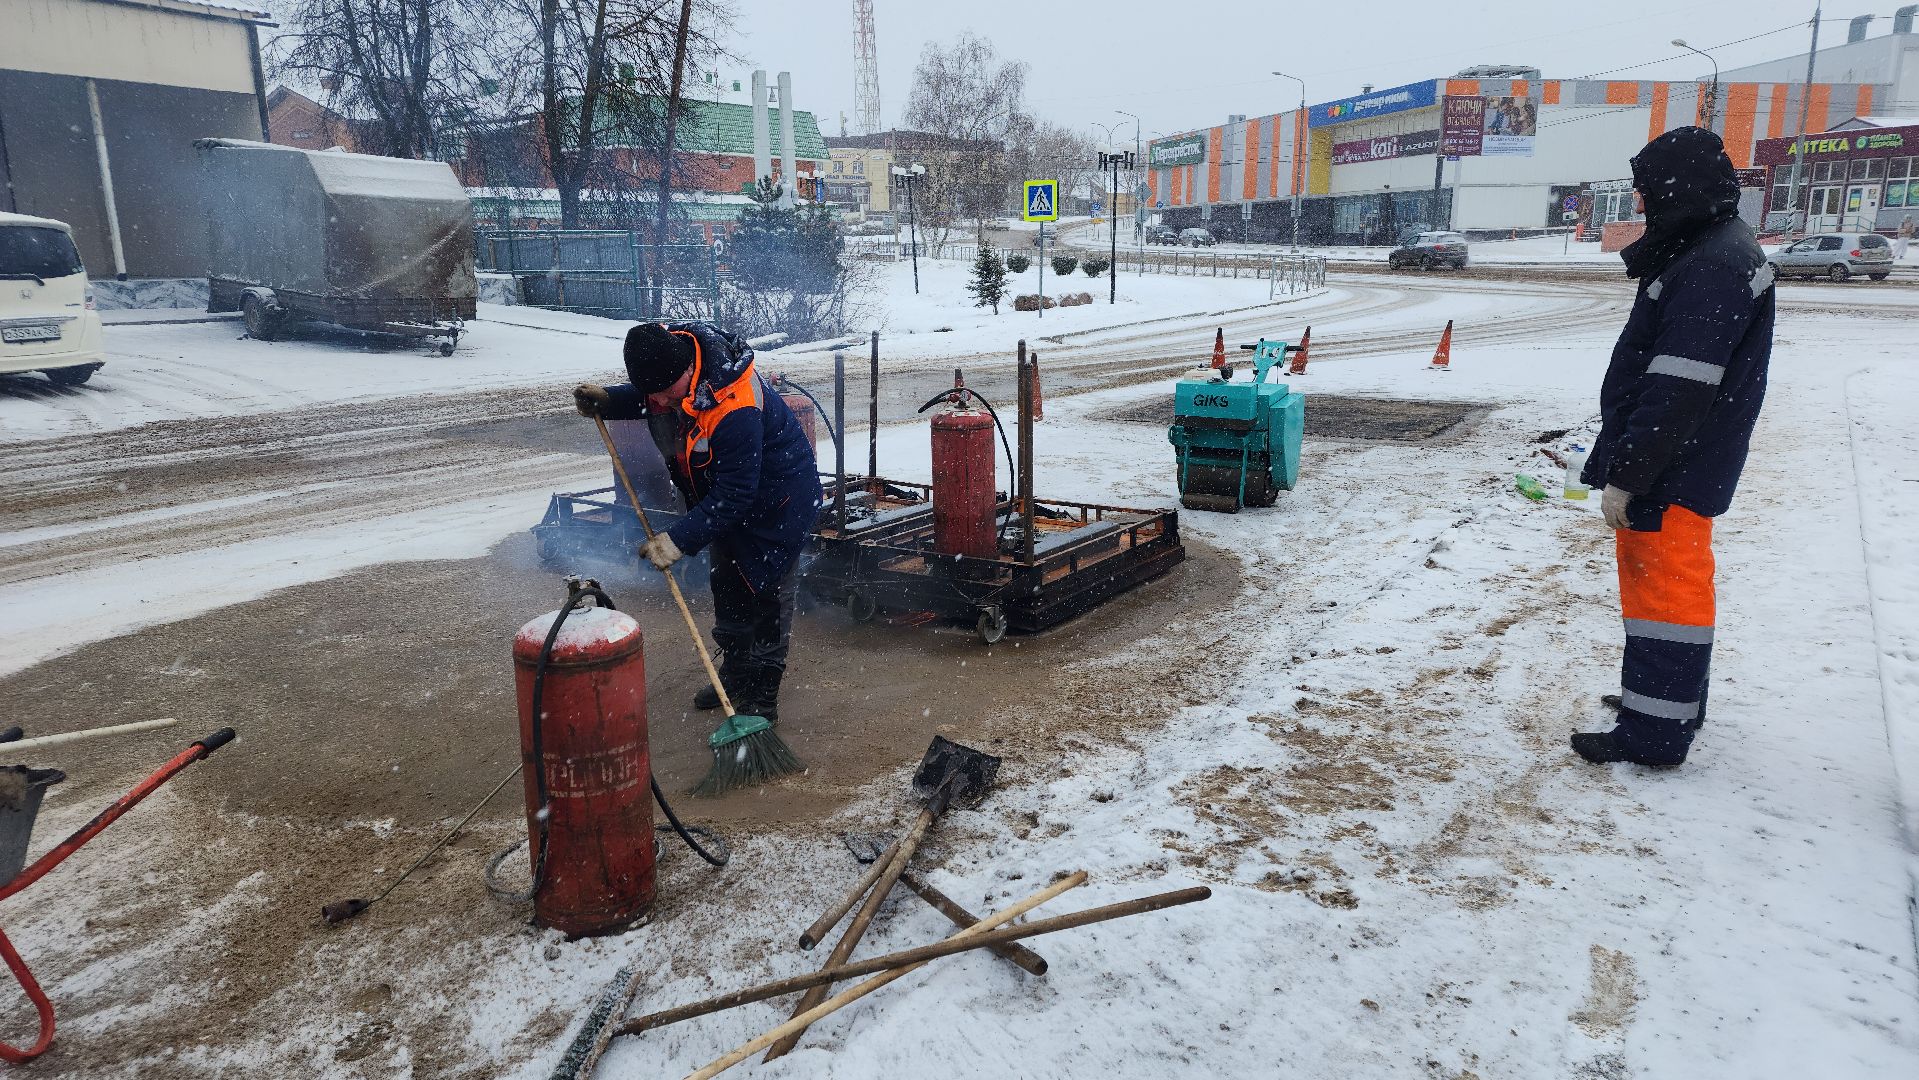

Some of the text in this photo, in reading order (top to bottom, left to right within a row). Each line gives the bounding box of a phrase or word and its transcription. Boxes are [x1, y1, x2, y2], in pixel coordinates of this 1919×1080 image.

[1448, 100, 1482, 114] КЛЮЧИ
[1869, 133, 1902, 142] ПЛАНЕТА
[1370, 137, 1397, 159] kari
[1399, 140, 1438, 152] LAZURIT
[1193, 394, 1229, 408] GIKS
